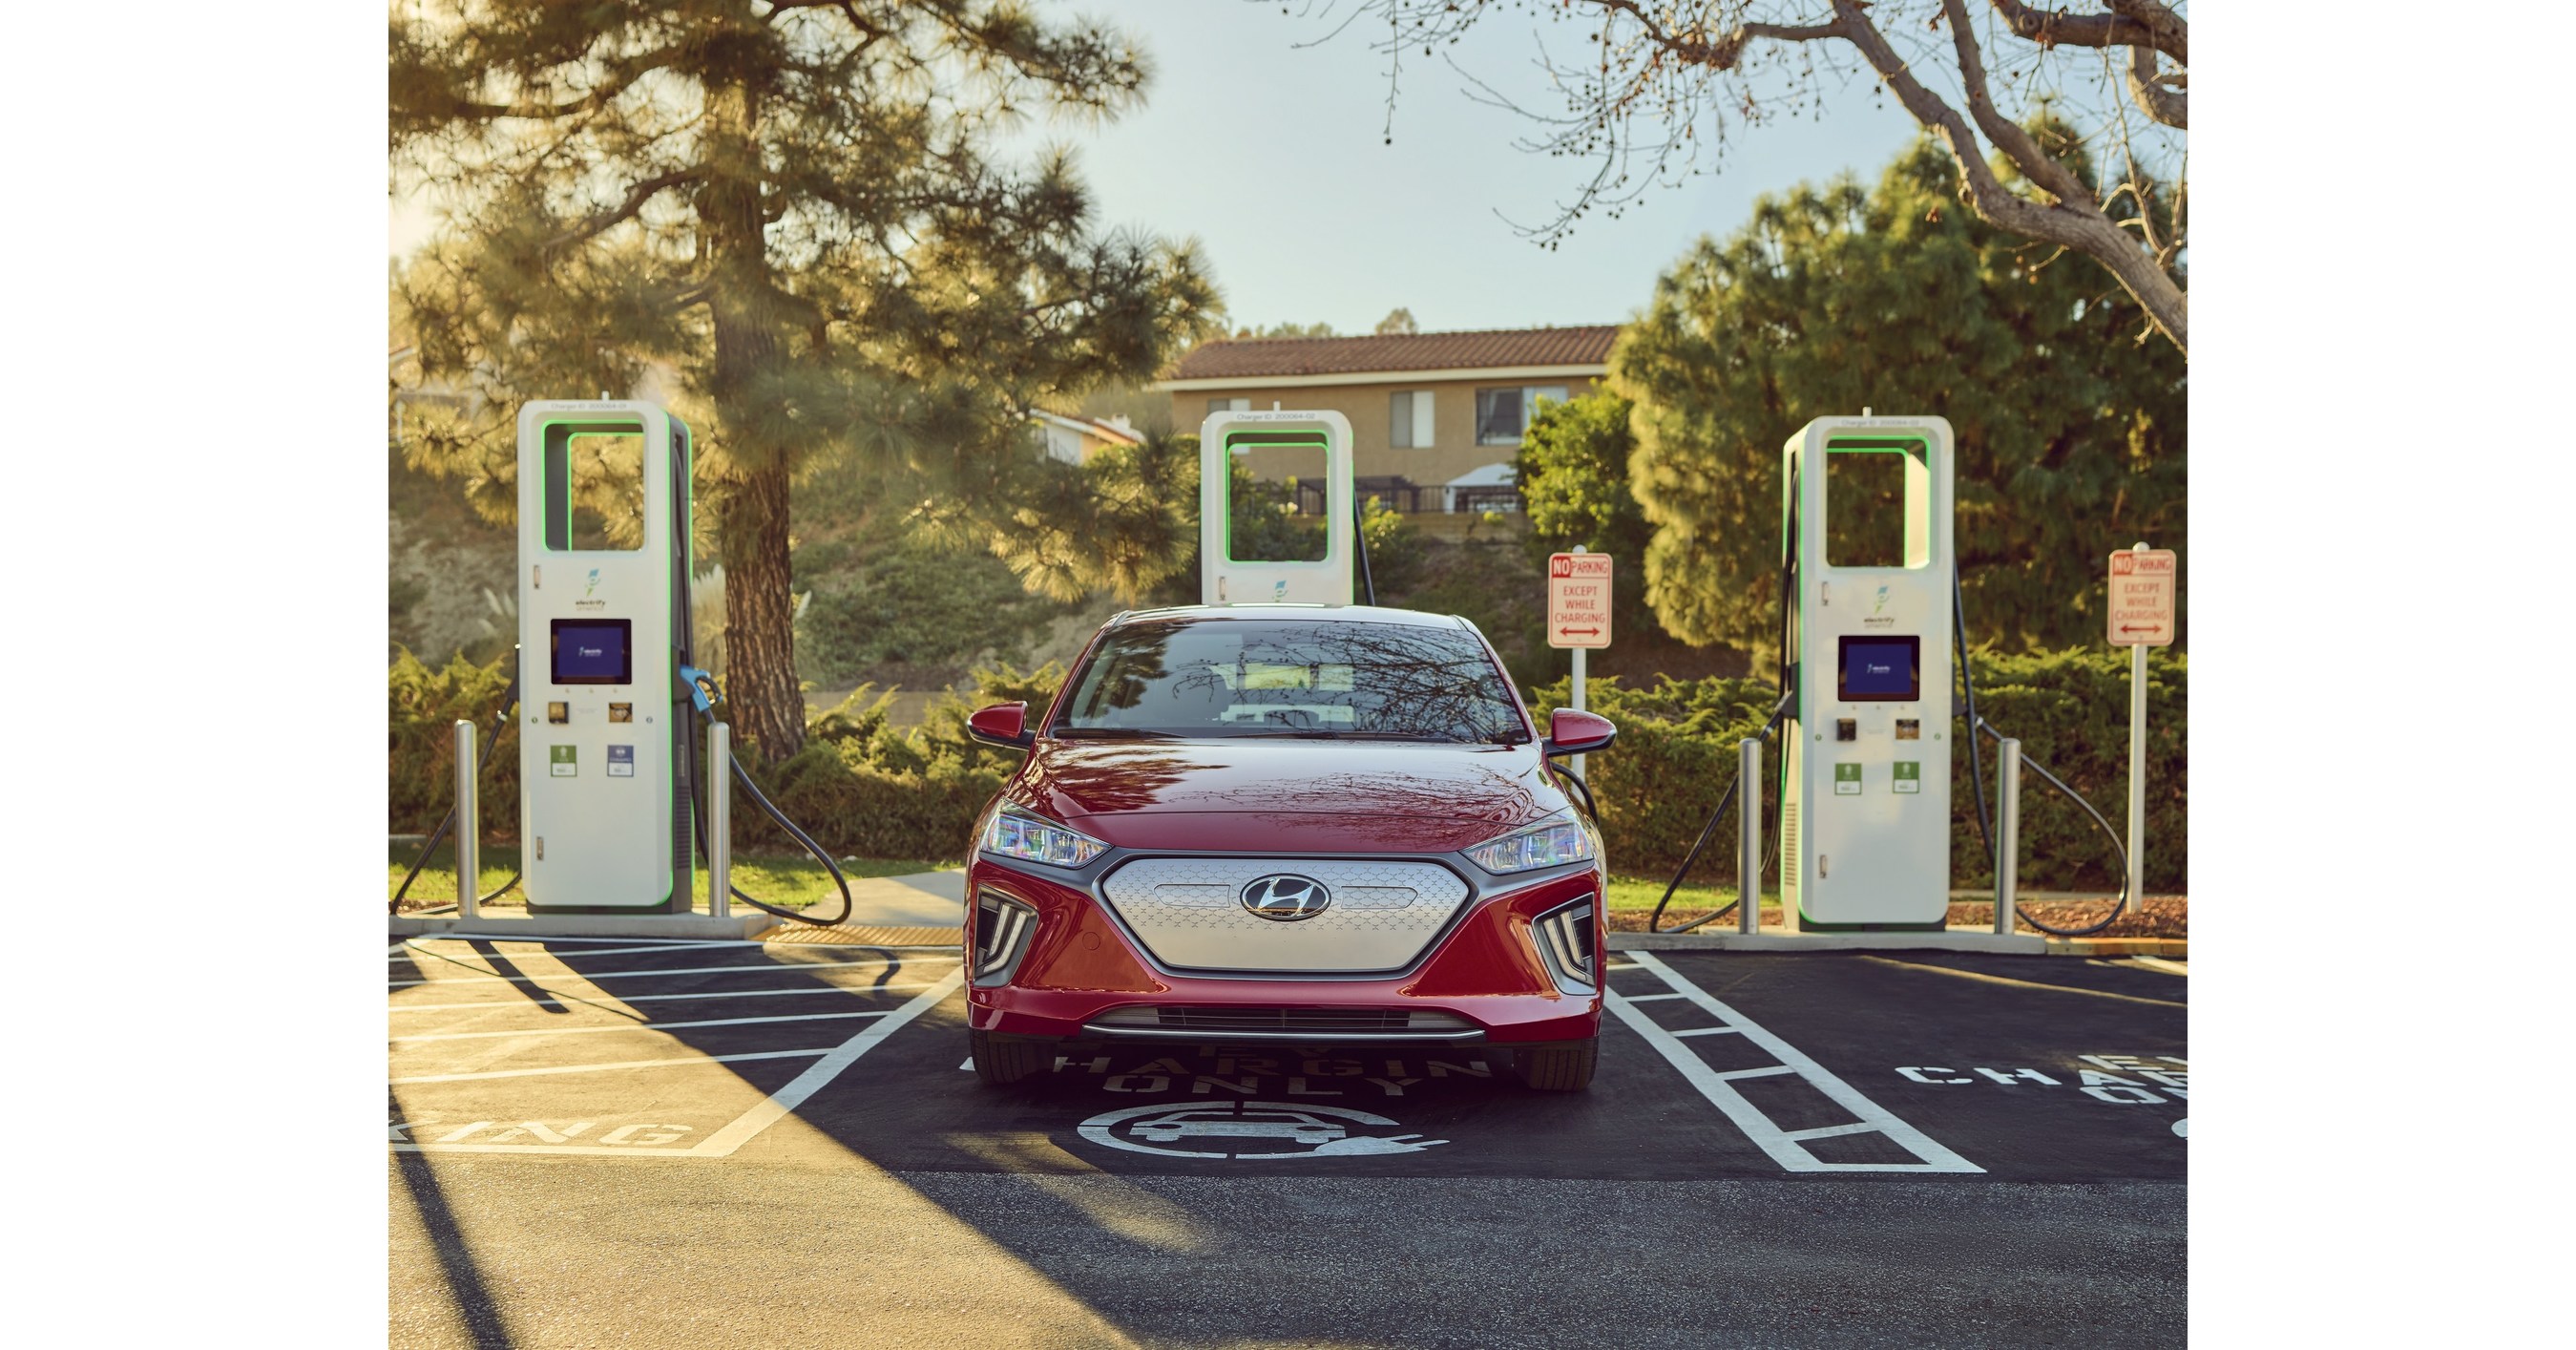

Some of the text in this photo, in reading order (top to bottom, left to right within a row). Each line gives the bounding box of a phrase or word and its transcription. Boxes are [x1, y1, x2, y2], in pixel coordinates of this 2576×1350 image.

[1552, 559, 1608, 576] NO PARKING
[2113, 556, 2171, 573] NO PARKING
[1563, 585, 1598, 596] EXCEPT
[2124, 583, 2160, 593] EXCEPT
[1565, 600, 1596, 609] WHILE
[2126, 597, 2157, 607] WHILE
[1554, 612, 1605, 622] CHARGING
[2115, 610, 2168, 621] CHARGING
[959, 1056, 1494, 1077] HARGIN
[1102, 1074, 1424, 1096] ONLY
